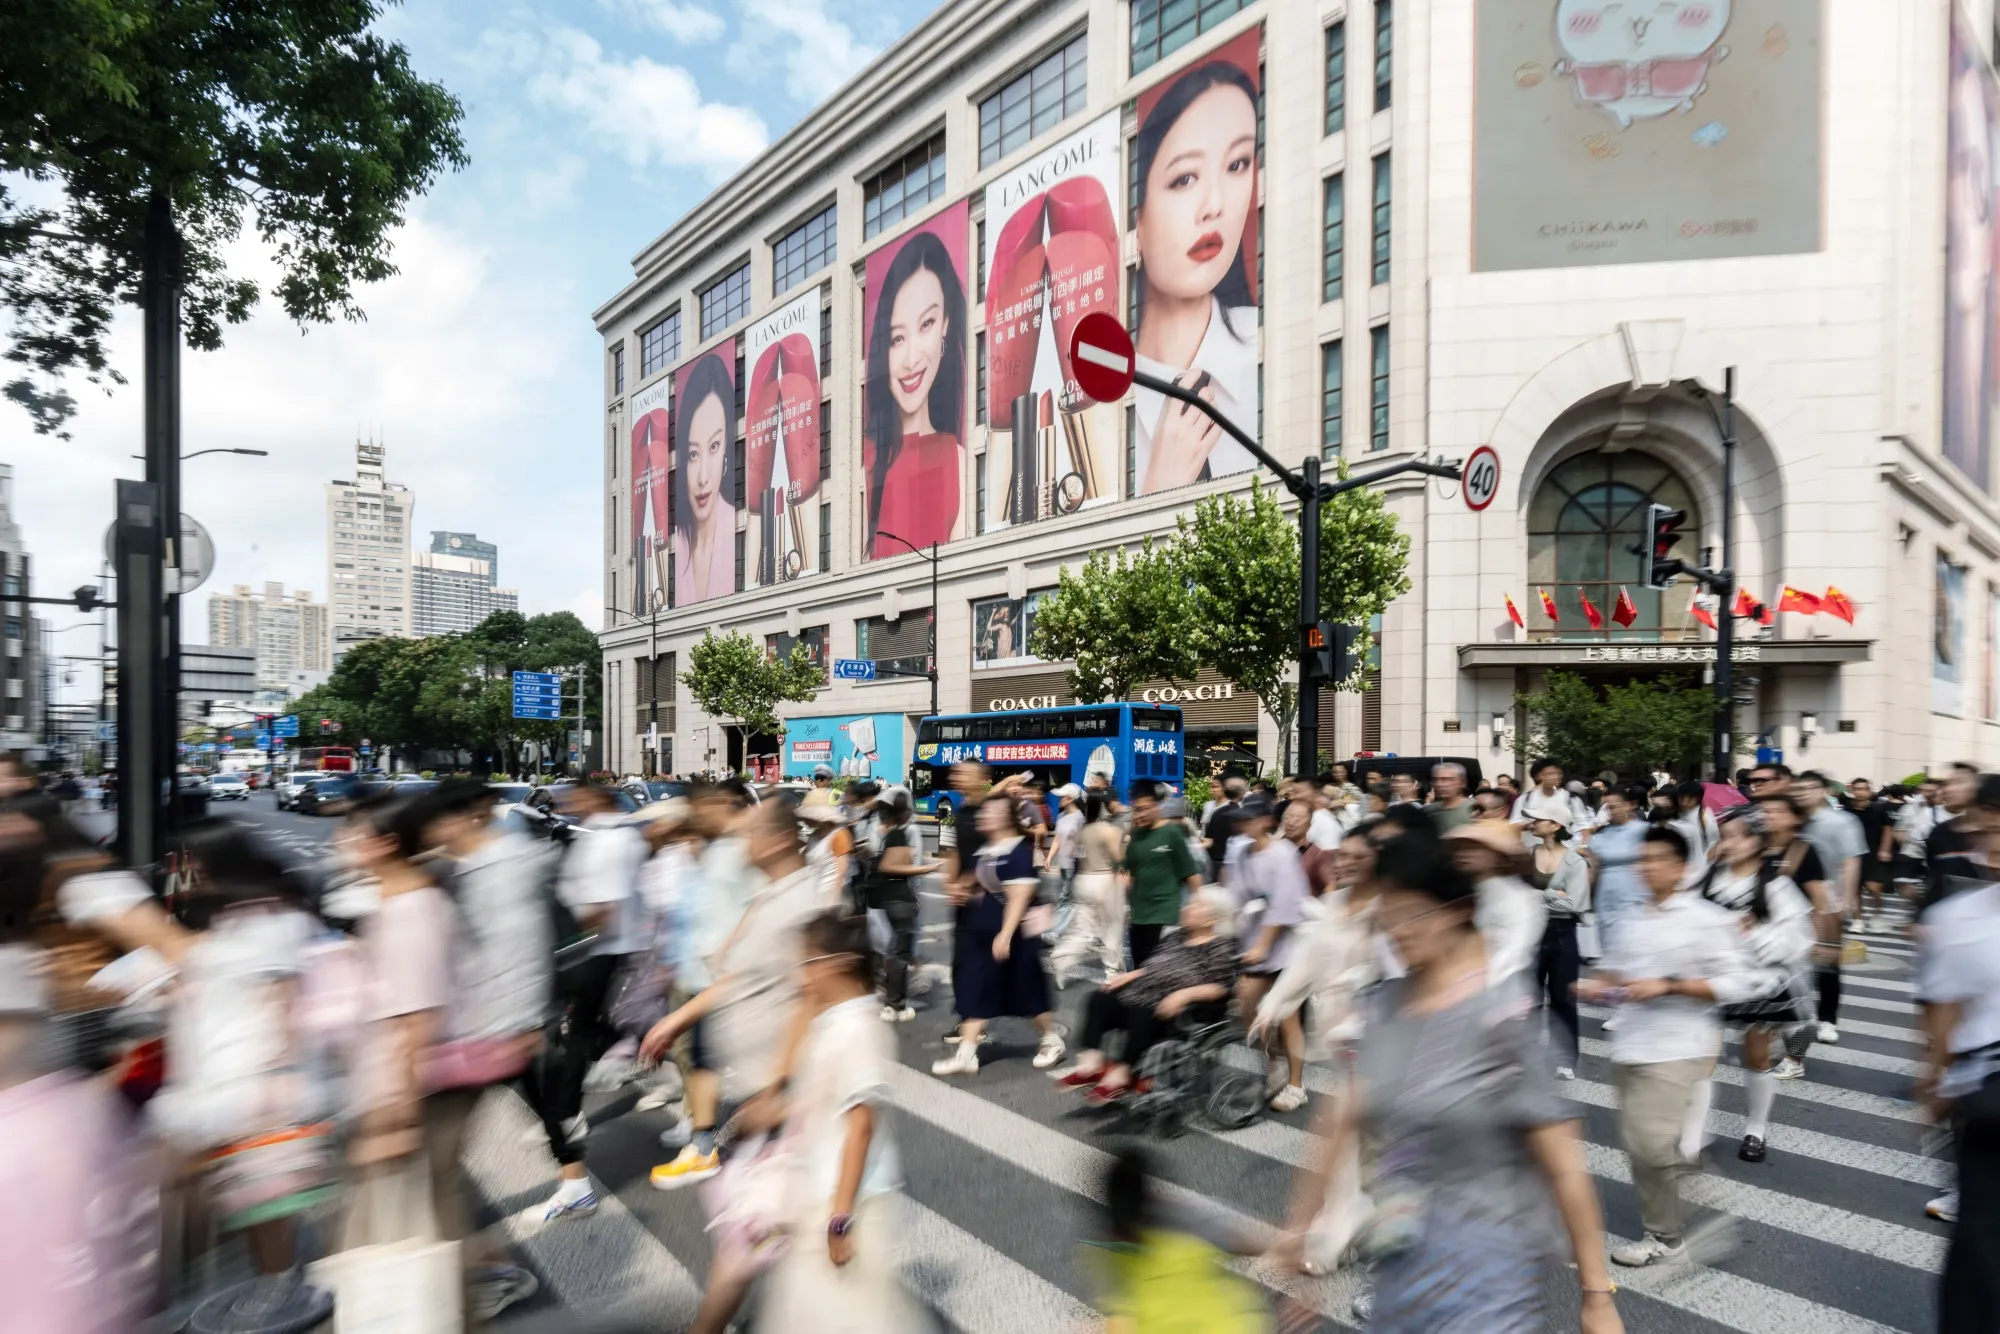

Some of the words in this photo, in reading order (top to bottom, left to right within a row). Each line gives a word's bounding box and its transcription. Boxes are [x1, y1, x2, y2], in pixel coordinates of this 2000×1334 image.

[1469, 462, 1494, 496] 40
[1142, 683, 1234, 703] COACH
[989, 695, 1057, 711] COACH
[987, 744, 1067, 760] 源自安吉生态大山深处
[1134, 738, 1178, 755] 洞庭山泉
